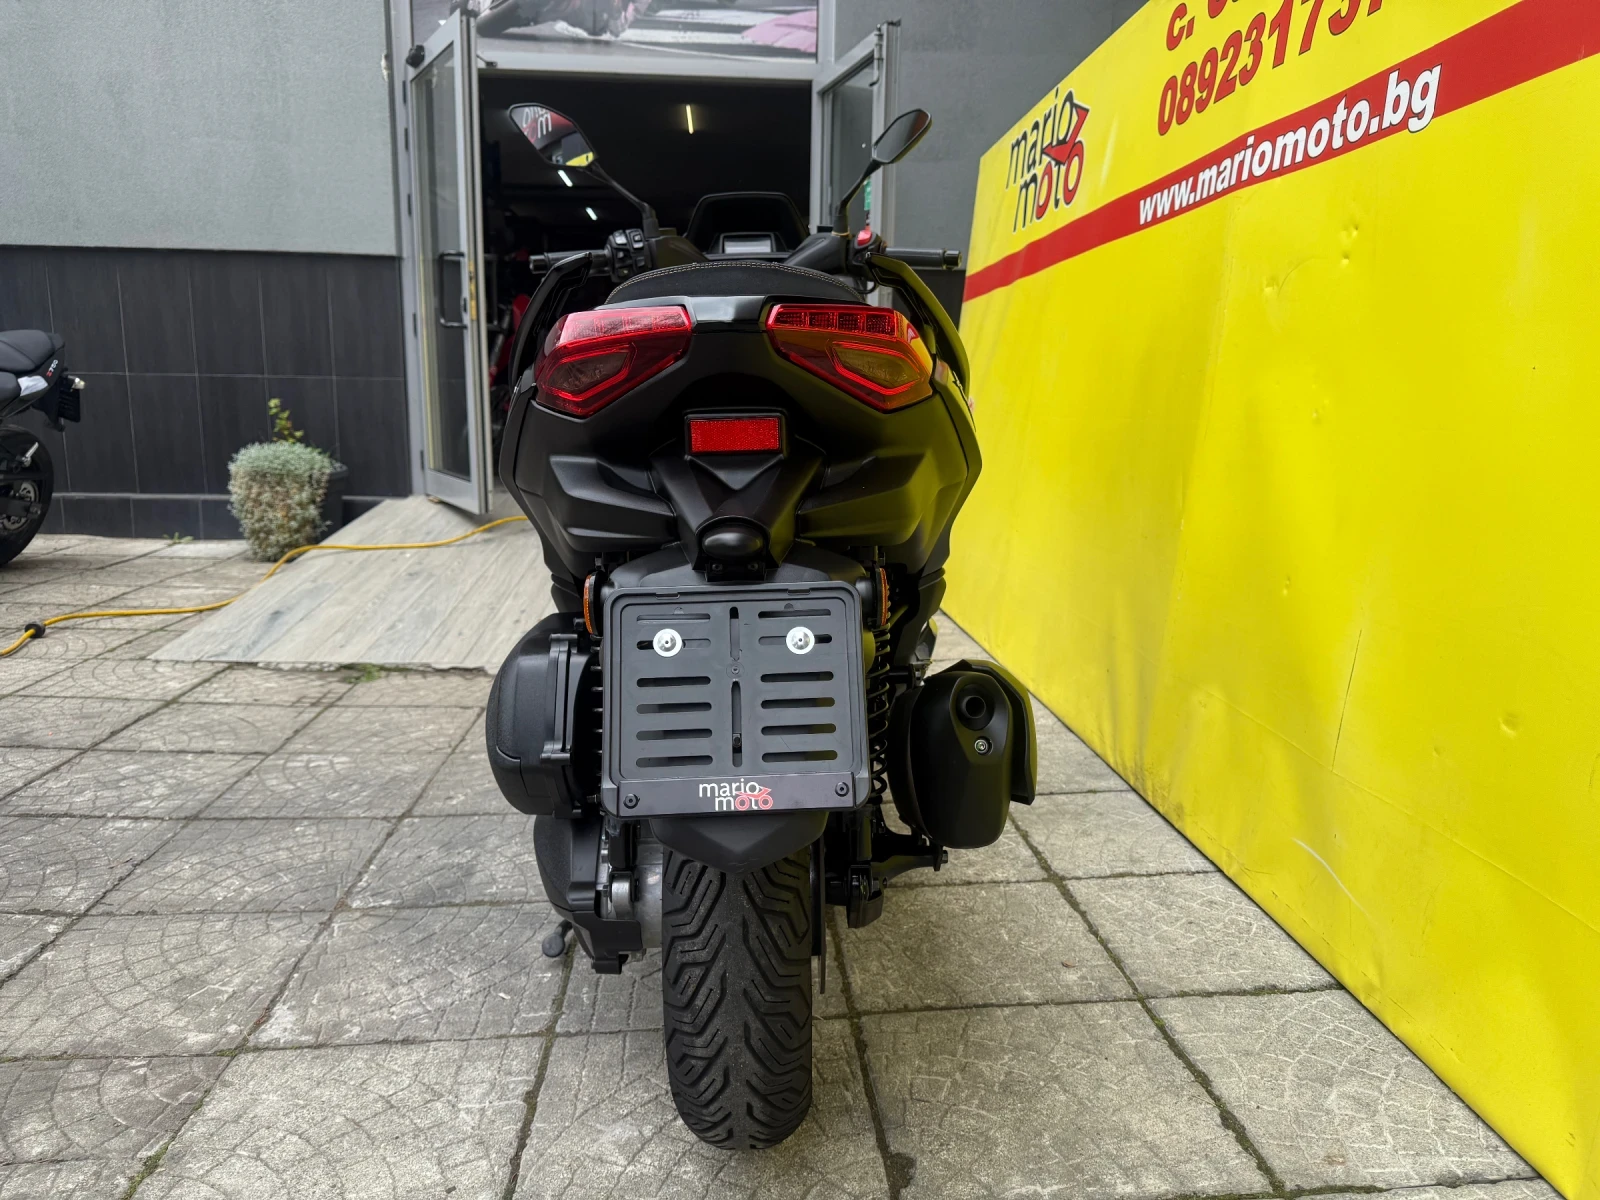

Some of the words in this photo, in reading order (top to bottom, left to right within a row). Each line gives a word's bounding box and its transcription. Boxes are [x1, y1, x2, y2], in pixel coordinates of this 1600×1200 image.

[1157, 0, 1384, 136] 0892317
[1005, 86, 1074, 190] mario
[1013, 139, 1085, 233] moto
[1139, 63, 1443, 226] www.mariomoto.bg
[698, 778, 760, 798] mario
[714, 794, 774, 811] moto
